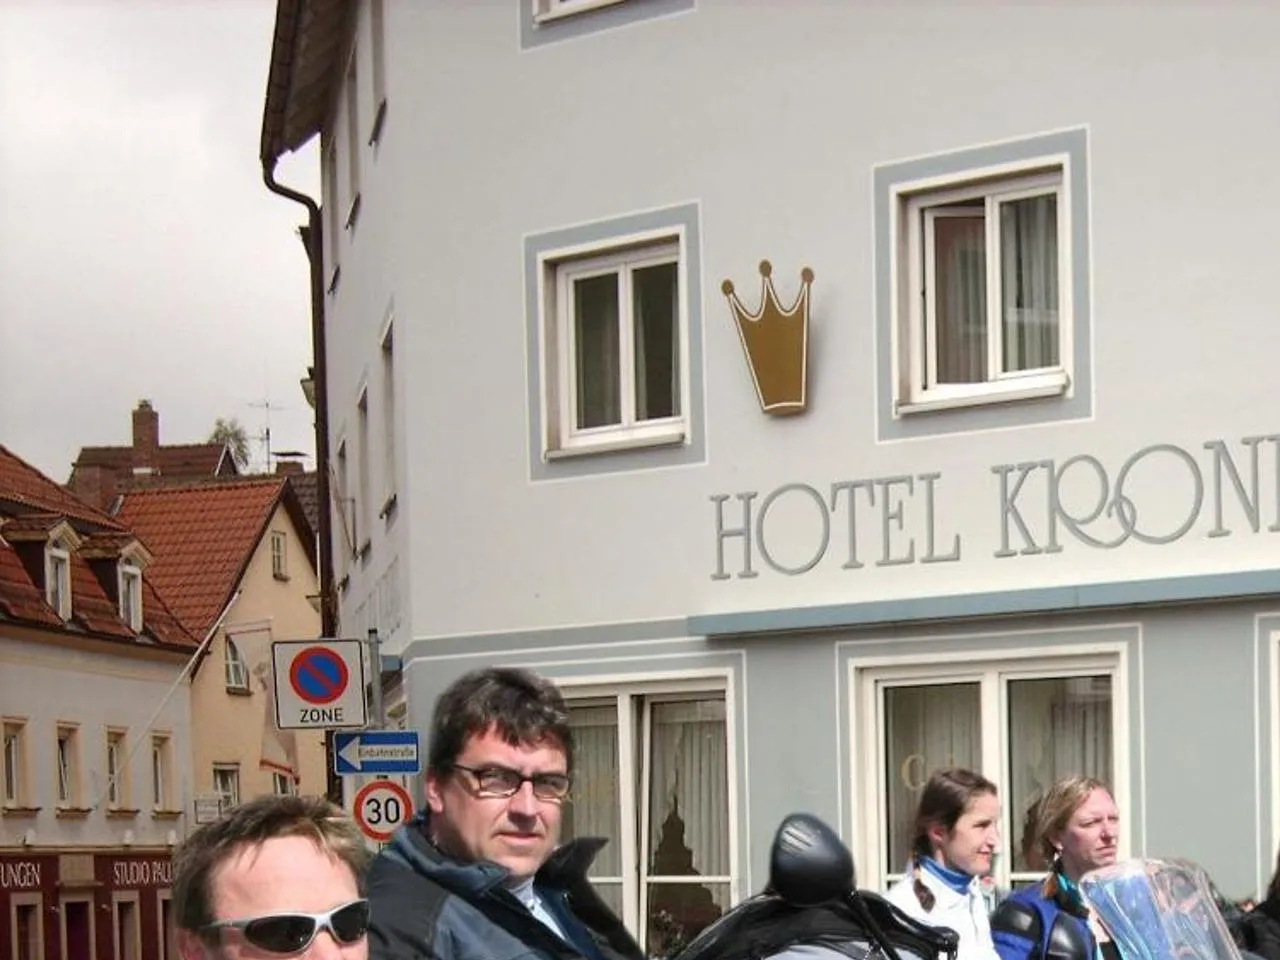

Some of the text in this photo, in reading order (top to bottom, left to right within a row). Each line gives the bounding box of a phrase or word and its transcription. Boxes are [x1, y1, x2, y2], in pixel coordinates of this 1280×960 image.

[710, 472, 961, 581] HOTEL
[300, 708, 344, 723] ZONE
[366, 797, 401, 825] 30
[0, 861, 41, 888] UNGEN
[113, 860, 174, 885] STUDIO PAU
